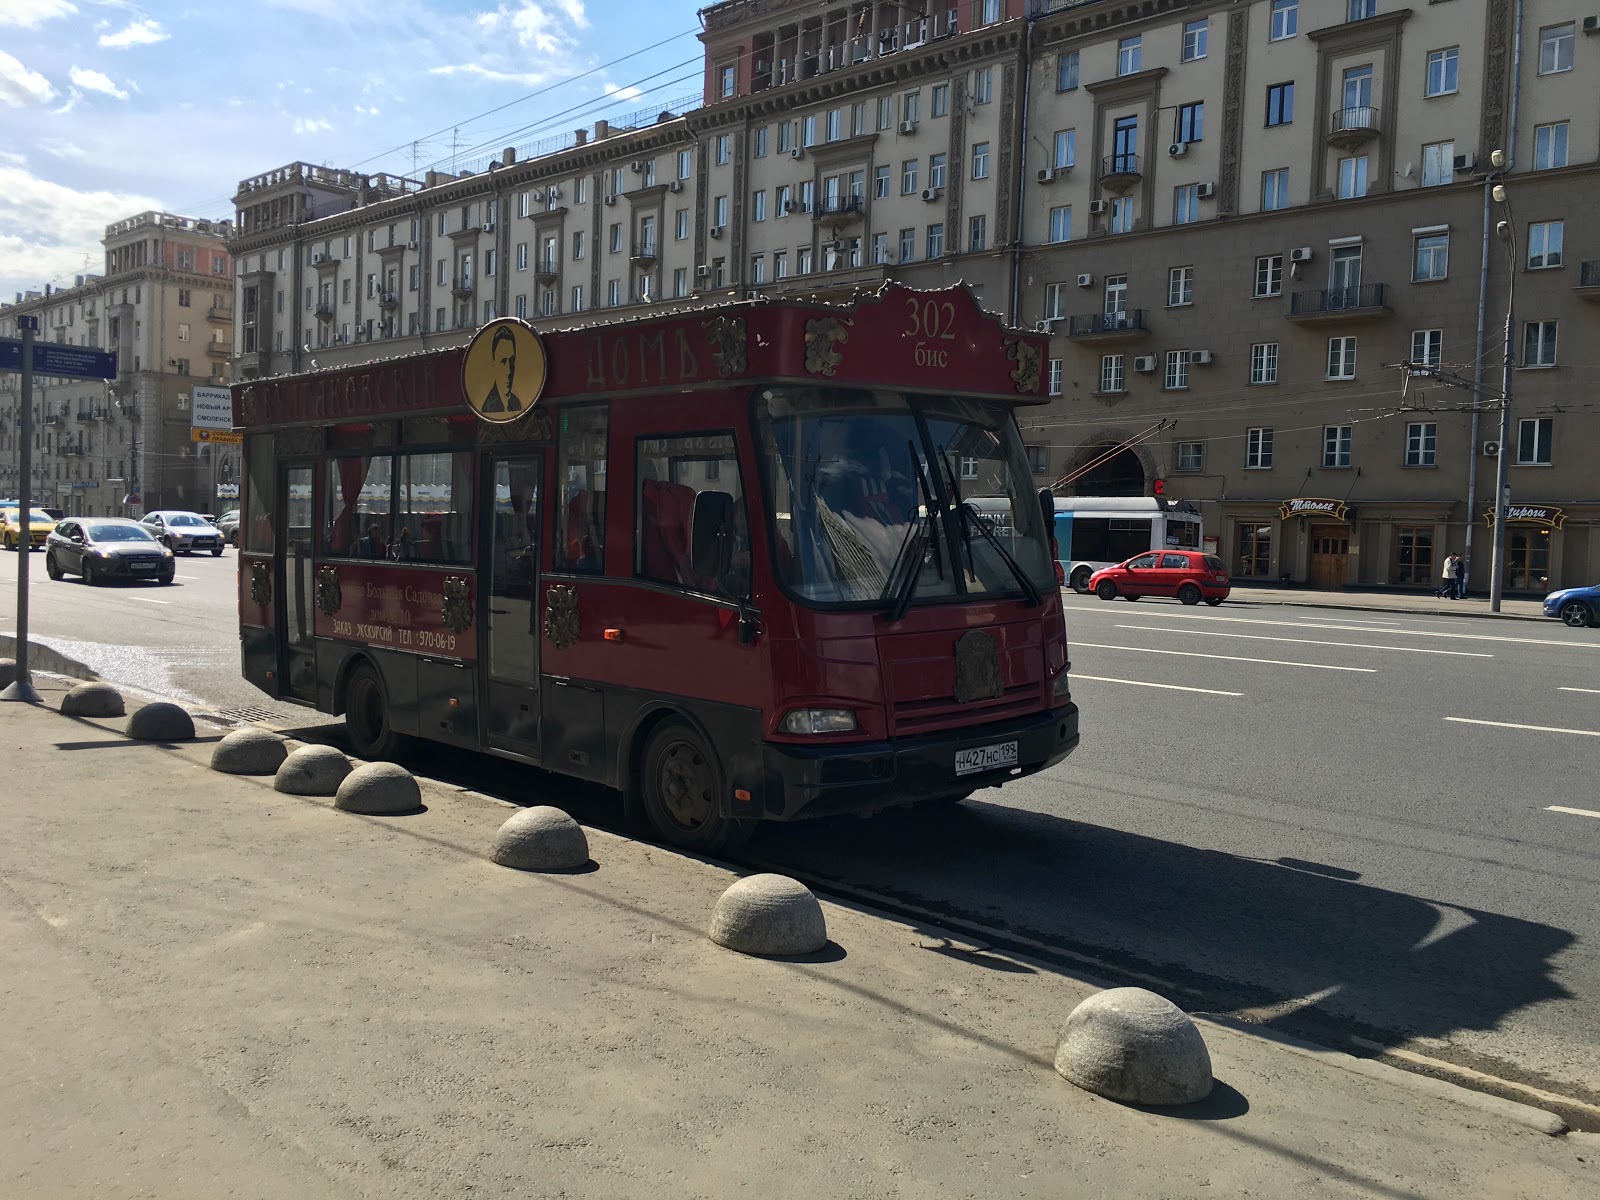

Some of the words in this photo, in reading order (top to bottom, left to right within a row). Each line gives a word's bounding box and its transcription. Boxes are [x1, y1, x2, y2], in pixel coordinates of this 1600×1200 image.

[905, 297, 956, 341] 302
[586, 327, 699, 389] ДОМЪ
[914, 341, 948, 369] бис
[197, 391, 231, 401] БАРРИКАД
[196, 403, 221, 411] НОВЫЙ
[196, 414, 232, 423] СМОЛЕНСК
[970, 525, 1009, 537] FLRE
[405, 585, 443, 607] Садовая
[401, 610, 411, 624] 10
[333, 619, 352, 636] ЗАКАЗ
[356, 623, 393, 642] ЭКСКУРСИЙ
[398, 629, 412, 645] ТЕЛ
[1000, 743, 1017, 756] 199
